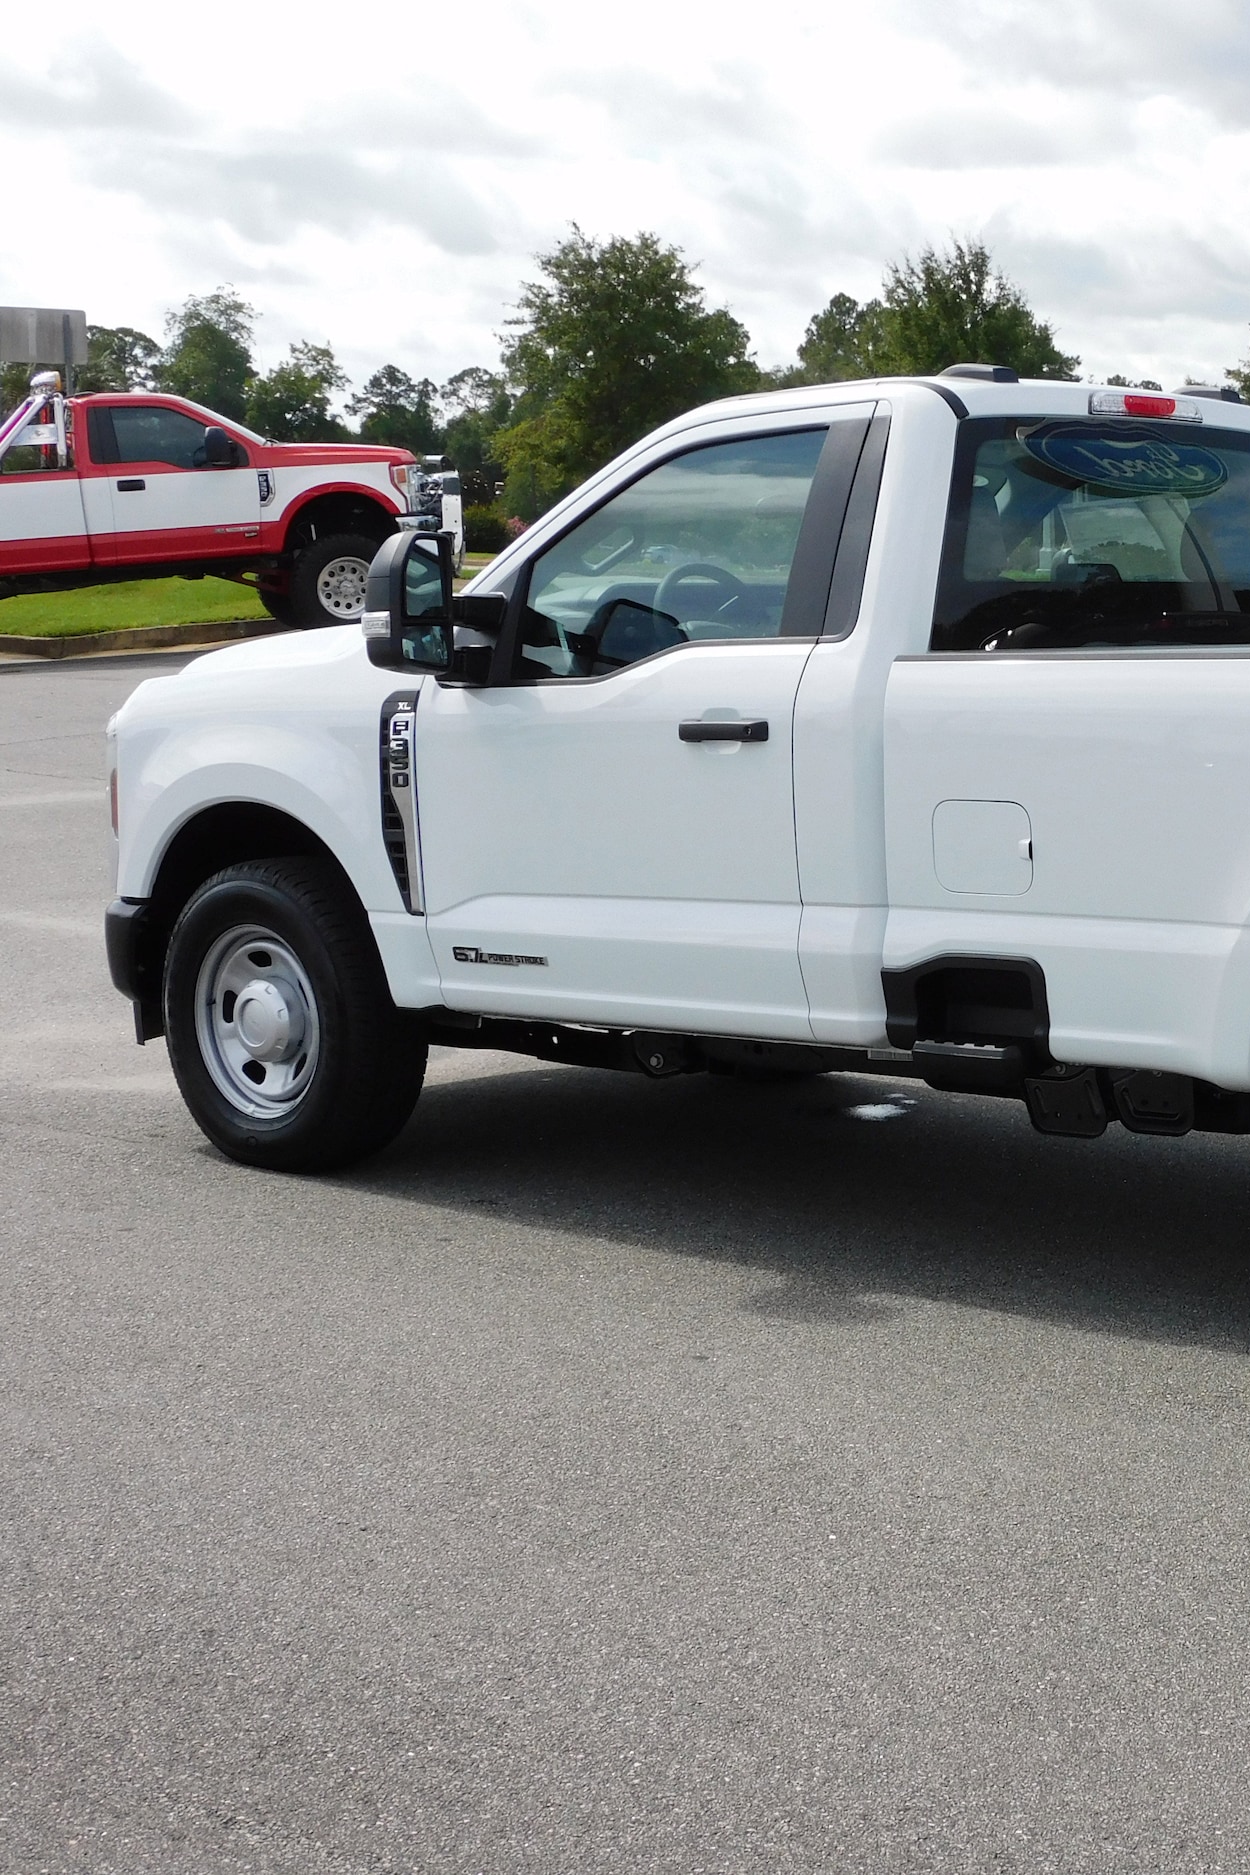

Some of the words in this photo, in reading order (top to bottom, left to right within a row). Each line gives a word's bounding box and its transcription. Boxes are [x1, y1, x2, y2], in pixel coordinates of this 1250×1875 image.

[397, 702, 412, 711] XL
[452, 945, 488, 963] 6.7L
[488, 953, 514, 963] POWER
[514, 955, 546, 966] STROKE
